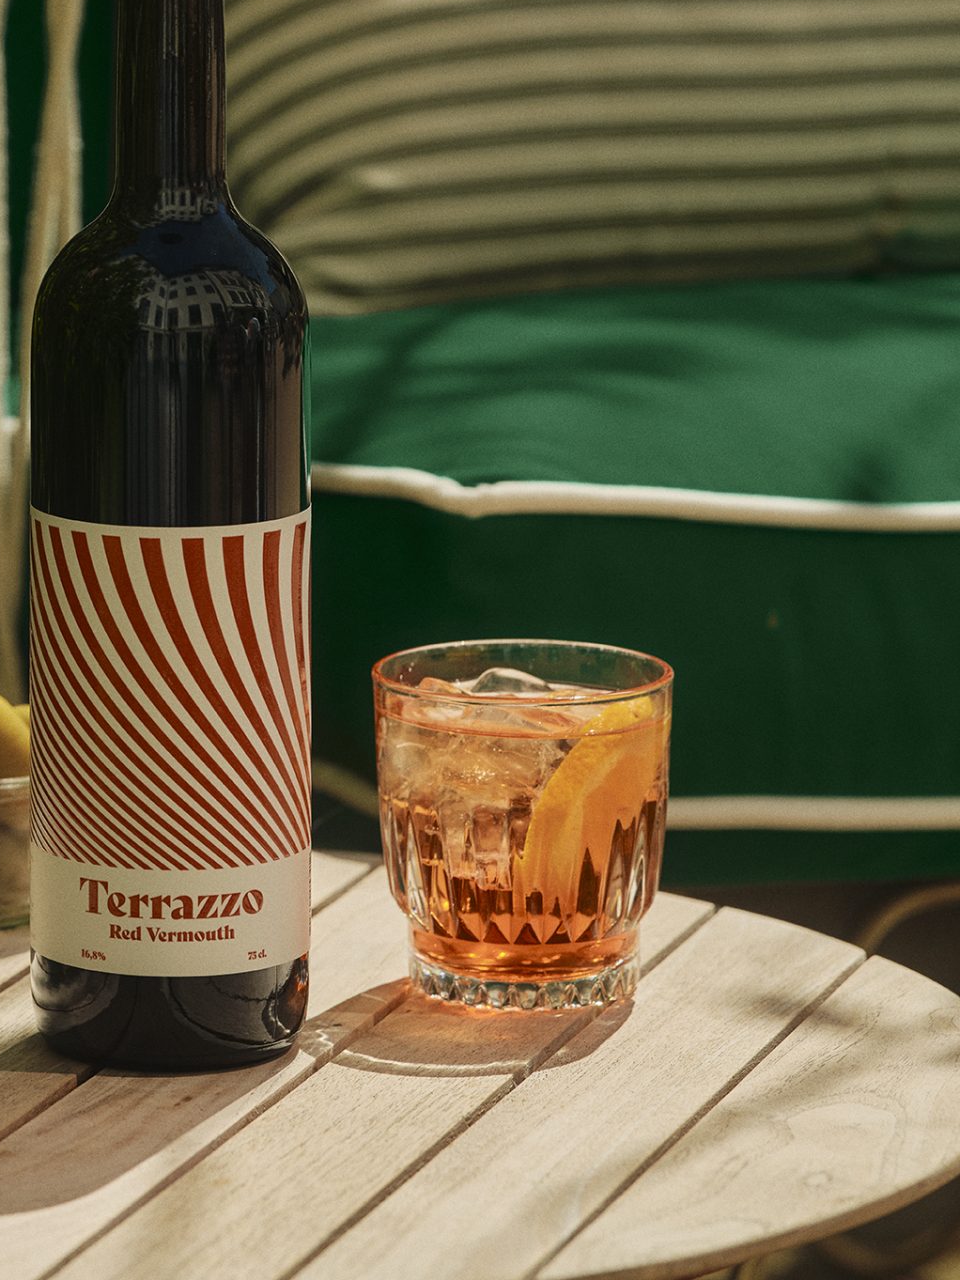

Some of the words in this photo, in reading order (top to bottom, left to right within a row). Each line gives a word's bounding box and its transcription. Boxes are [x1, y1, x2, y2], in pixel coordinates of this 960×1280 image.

[80, 877, 263, 920] Terrazzo
[109, 924, 141, 942] Red
[146, 925, 235, 943] Vermouth
[81, 948, 106, 961] 16,8%
[247, 951, 257, 960] 75
